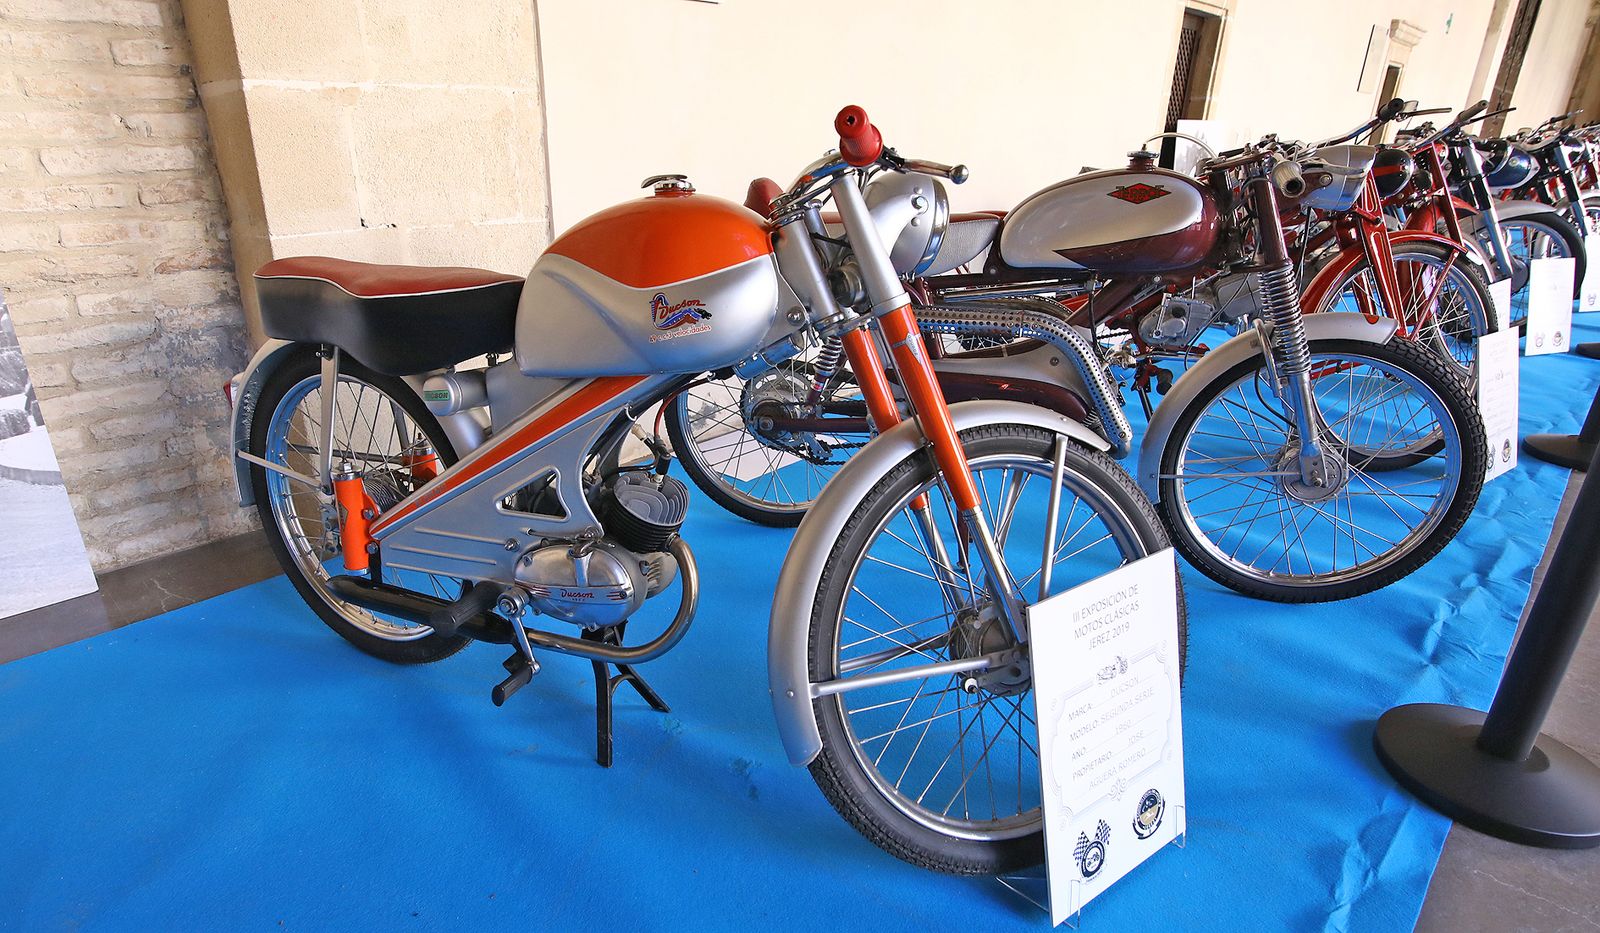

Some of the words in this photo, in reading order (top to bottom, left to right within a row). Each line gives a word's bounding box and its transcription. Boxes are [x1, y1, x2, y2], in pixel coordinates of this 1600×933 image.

[659, 299, 706, 319] Ducson
[560, 588, 594, 599] Ducson
[1128, 583, 1138, 598] DE
[1074, 617, 1103, 640] MOTOS
[1089, 631, 1111, 651] JEREZ
[1113, 622, 1130, 639] 2019
